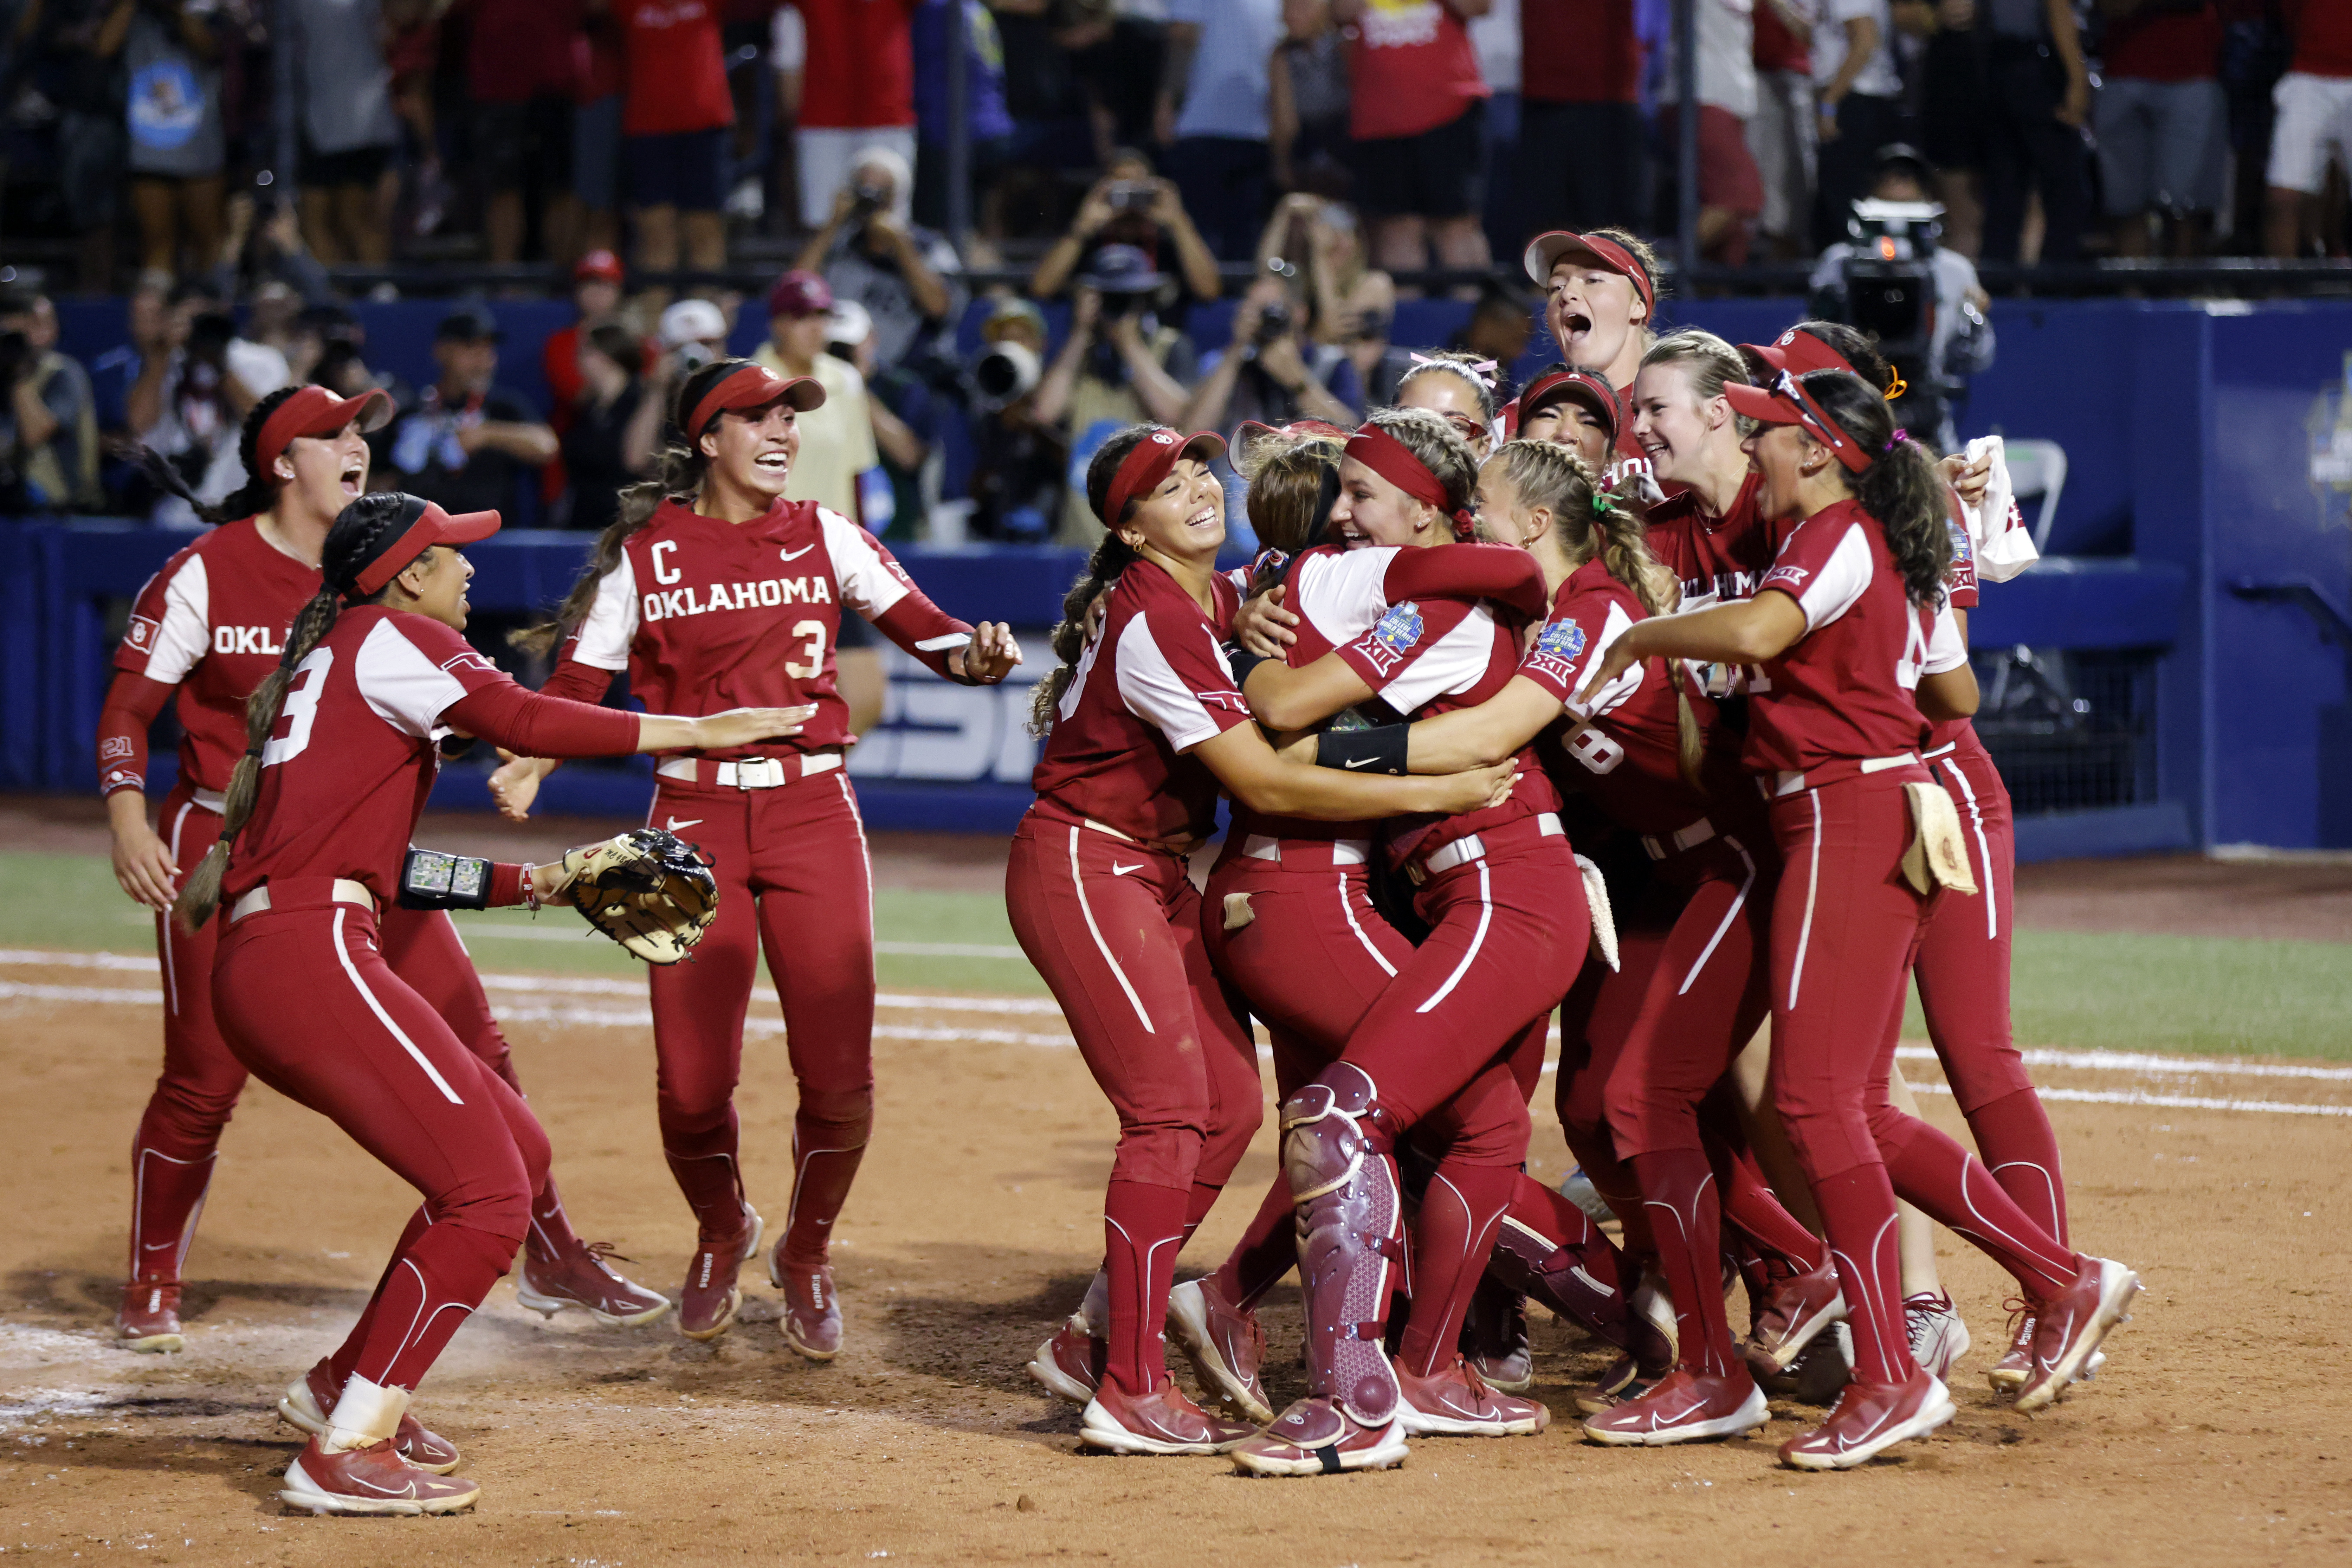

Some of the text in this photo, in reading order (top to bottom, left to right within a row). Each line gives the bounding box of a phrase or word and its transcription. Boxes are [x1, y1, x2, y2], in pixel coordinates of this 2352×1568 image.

[1152, 433, 1173, 445] OU
[651, 540, 682, 585] C
[644, 576, 832, 622] OKLAHOMA
[1379, 620, 1416, 643] WORLD SERIES
[1389, 617, 1412, 633] COLLEGE
[785, 620, 827, 679] 3
[1550, 633, 1575, 644] COLLEGE
[1560, 640, 1581, 652] SERIES
[101, 736, 134, 760] 21
[1561, 721, 1624, 775] 8
